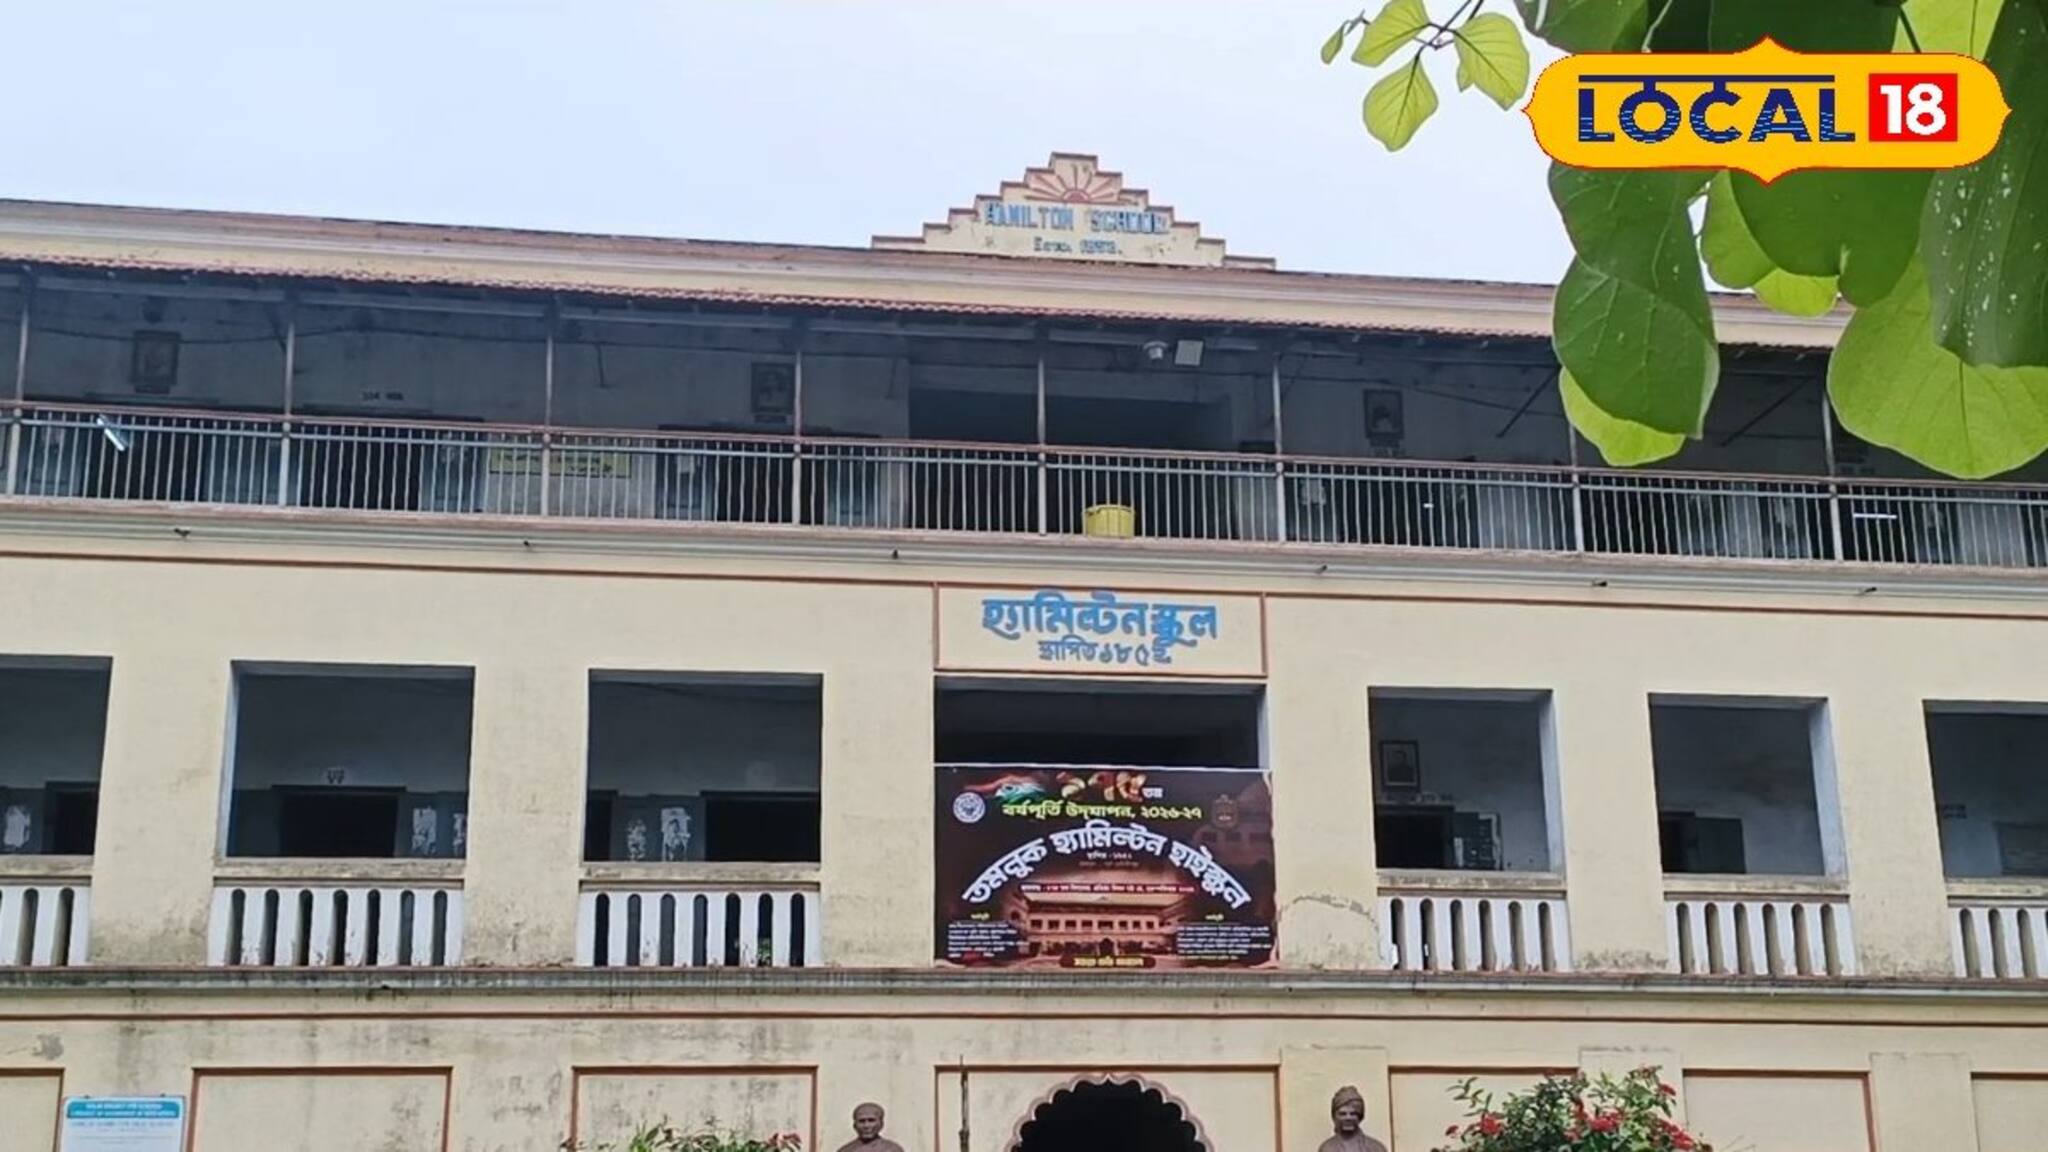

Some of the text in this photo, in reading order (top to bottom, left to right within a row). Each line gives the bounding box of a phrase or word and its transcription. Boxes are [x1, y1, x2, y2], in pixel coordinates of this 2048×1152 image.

[985, 201, 1169, 235] HAMILTON SCHOOL
[1002, 800, 1063, 820] বর্ষপূর্তি
[1050, 819, 1167, 856] হ্যামিল্টন
[1168, 840, 1252, 911] হাইস্কুল
